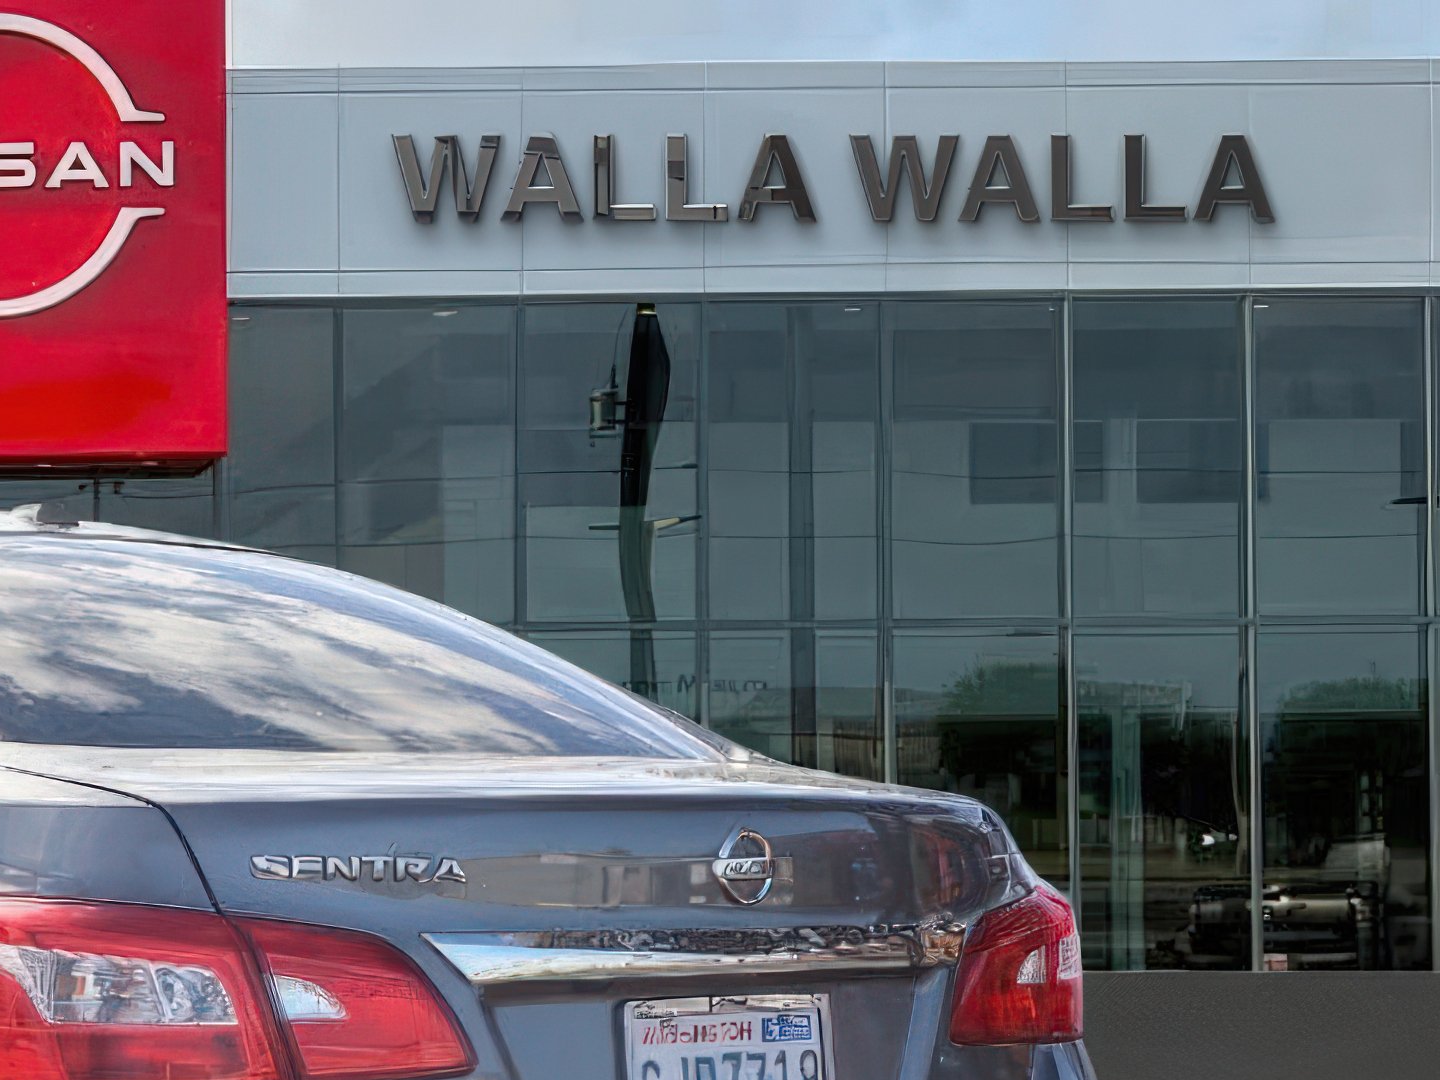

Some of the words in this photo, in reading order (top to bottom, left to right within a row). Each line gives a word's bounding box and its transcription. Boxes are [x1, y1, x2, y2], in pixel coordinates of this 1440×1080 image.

[390, 131, 817, 224] WALLA
[849, 132, 1276, 224] WALLA
[250, 854, 466, 884] SENTRA
